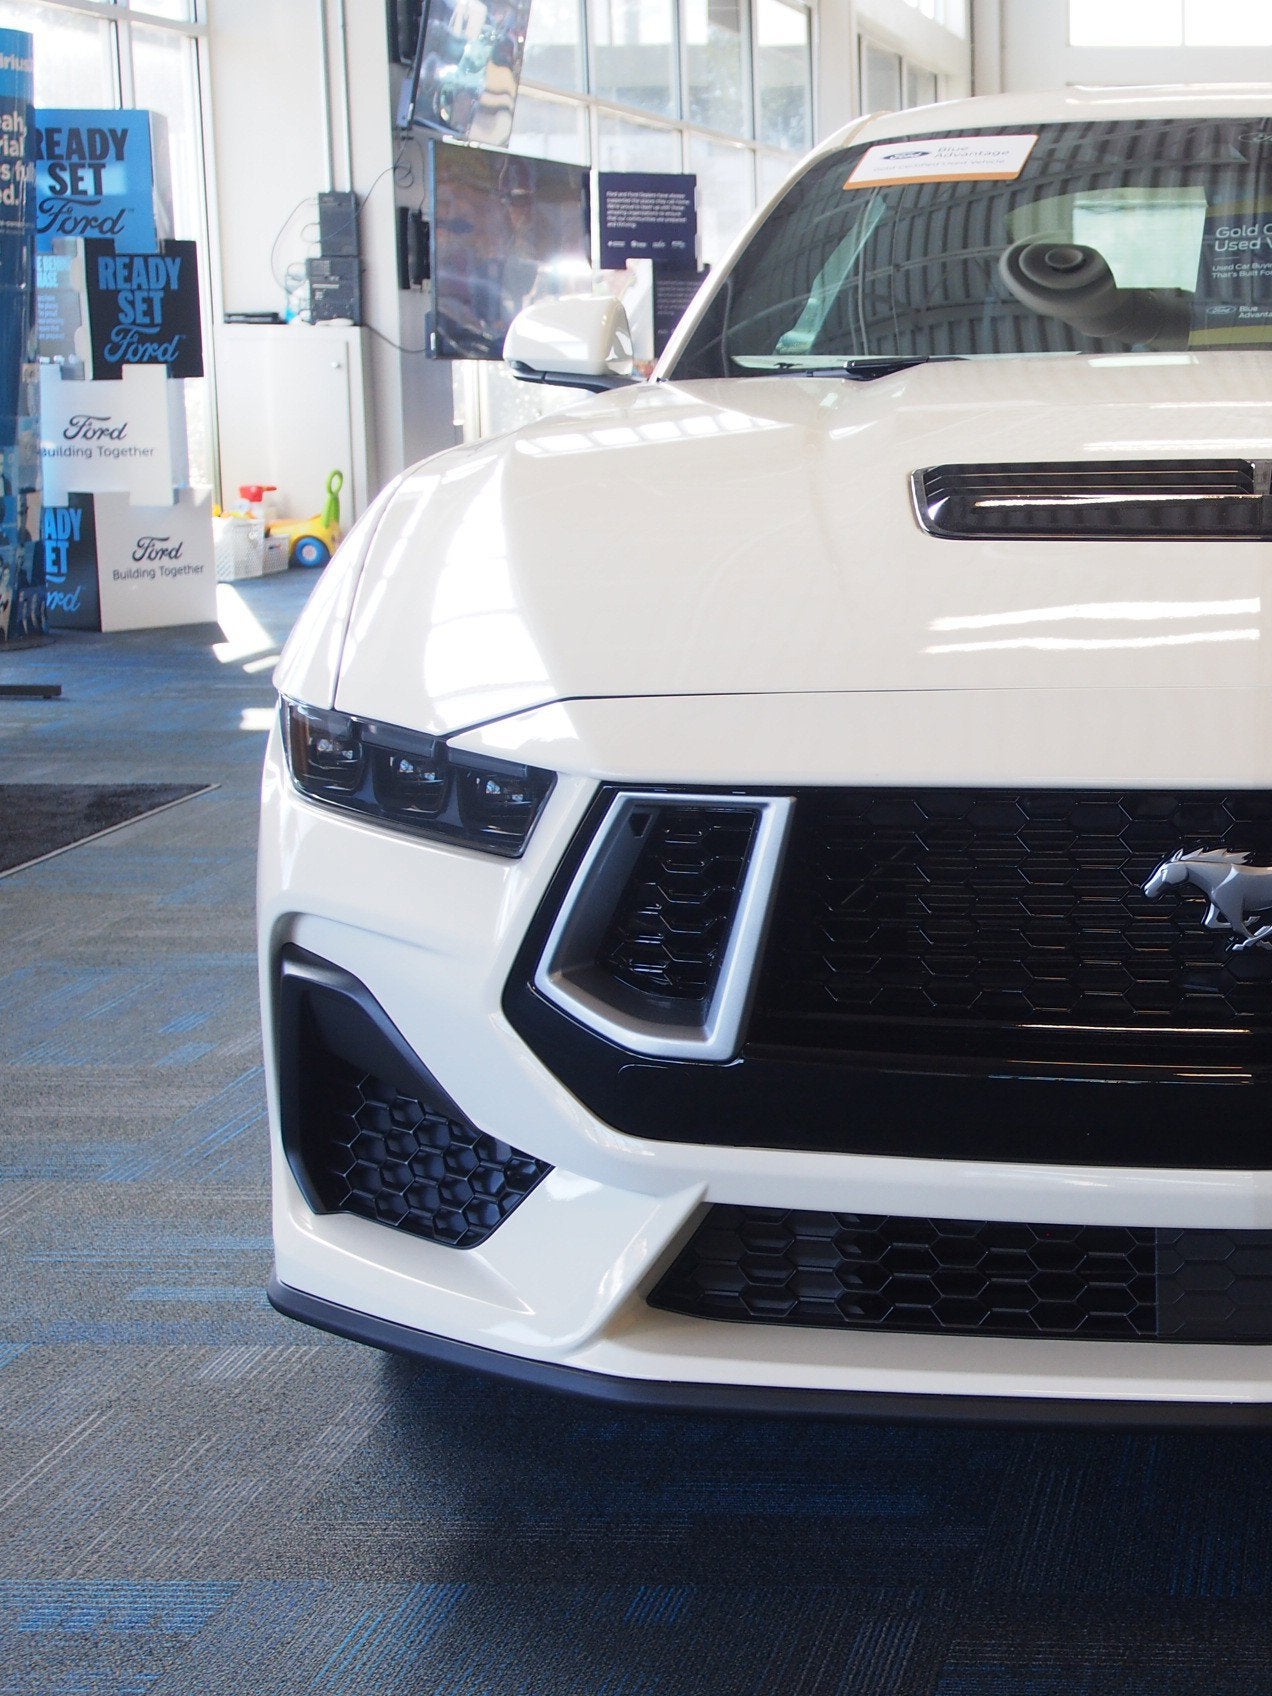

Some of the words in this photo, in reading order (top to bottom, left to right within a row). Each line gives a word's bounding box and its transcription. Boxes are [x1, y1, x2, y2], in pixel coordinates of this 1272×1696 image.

[48, 162, 106, 196] SET
[36, 197, 127, 235] Ford
[1215, 223, 1259, 238] Gold
[1214, 238, 1260, 252] Used
[97, 256, 183, 290] READY
[1212, 263, 1234, 272] Used
[117, 289, 165, 325] SET
[103, 324, 182, 363] Ford
[63, 414, 128, 440] Ford
[96, 445, 154, 459] Together
[132, 536, 183, 562] Ford
[112, 568, 156, 582] Building
[160, 564, 204, 578] Together
